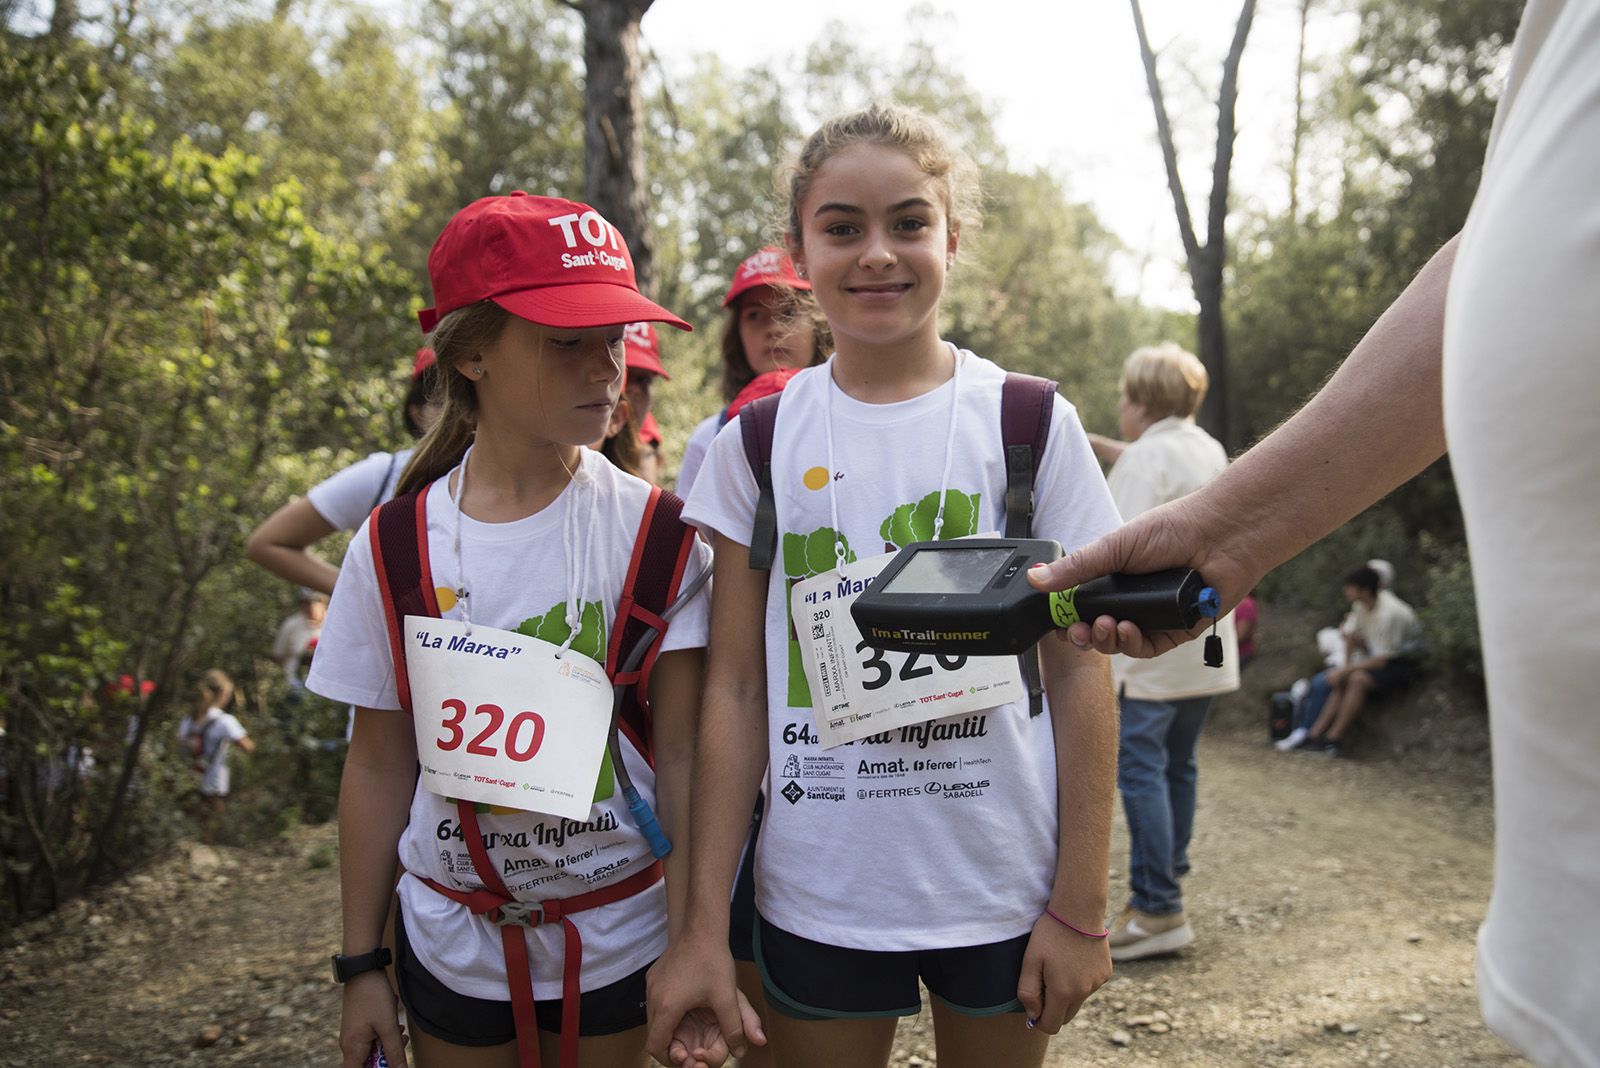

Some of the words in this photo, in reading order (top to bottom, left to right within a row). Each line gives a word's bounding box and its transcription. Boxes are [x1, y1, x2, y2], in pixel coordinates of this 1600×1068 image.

[547, 210, 619, 251] TOT
[560, 251, 596, 269] Sant
[598, 251, 628, 271] Cugat
[836, 575, 878, 599] Mar
[813, 609, 831, 622] 320
[919, 695, 933, 704] TOT
[947, 689, 964, 698] Cugat
[436, 698, 546, 762] 320
[897, 715, 988, 749] Infantil
[857, 757, 909, 775] Amat.
[926, 759, 957, 771] ferrer
[868, 787, 921, 798] FERTRES
[943, 779, 991, 791] LEXUS
[943, 789, 984, 799] SABADELL
[481, 830, 531, 851] arxa
[532, 810, 620, 848] Infantil
[565, 848, 595, 866] ferrer
[586, 856, 630, 879] LEXUS
[518, 871, 568, 892] FERTRES
